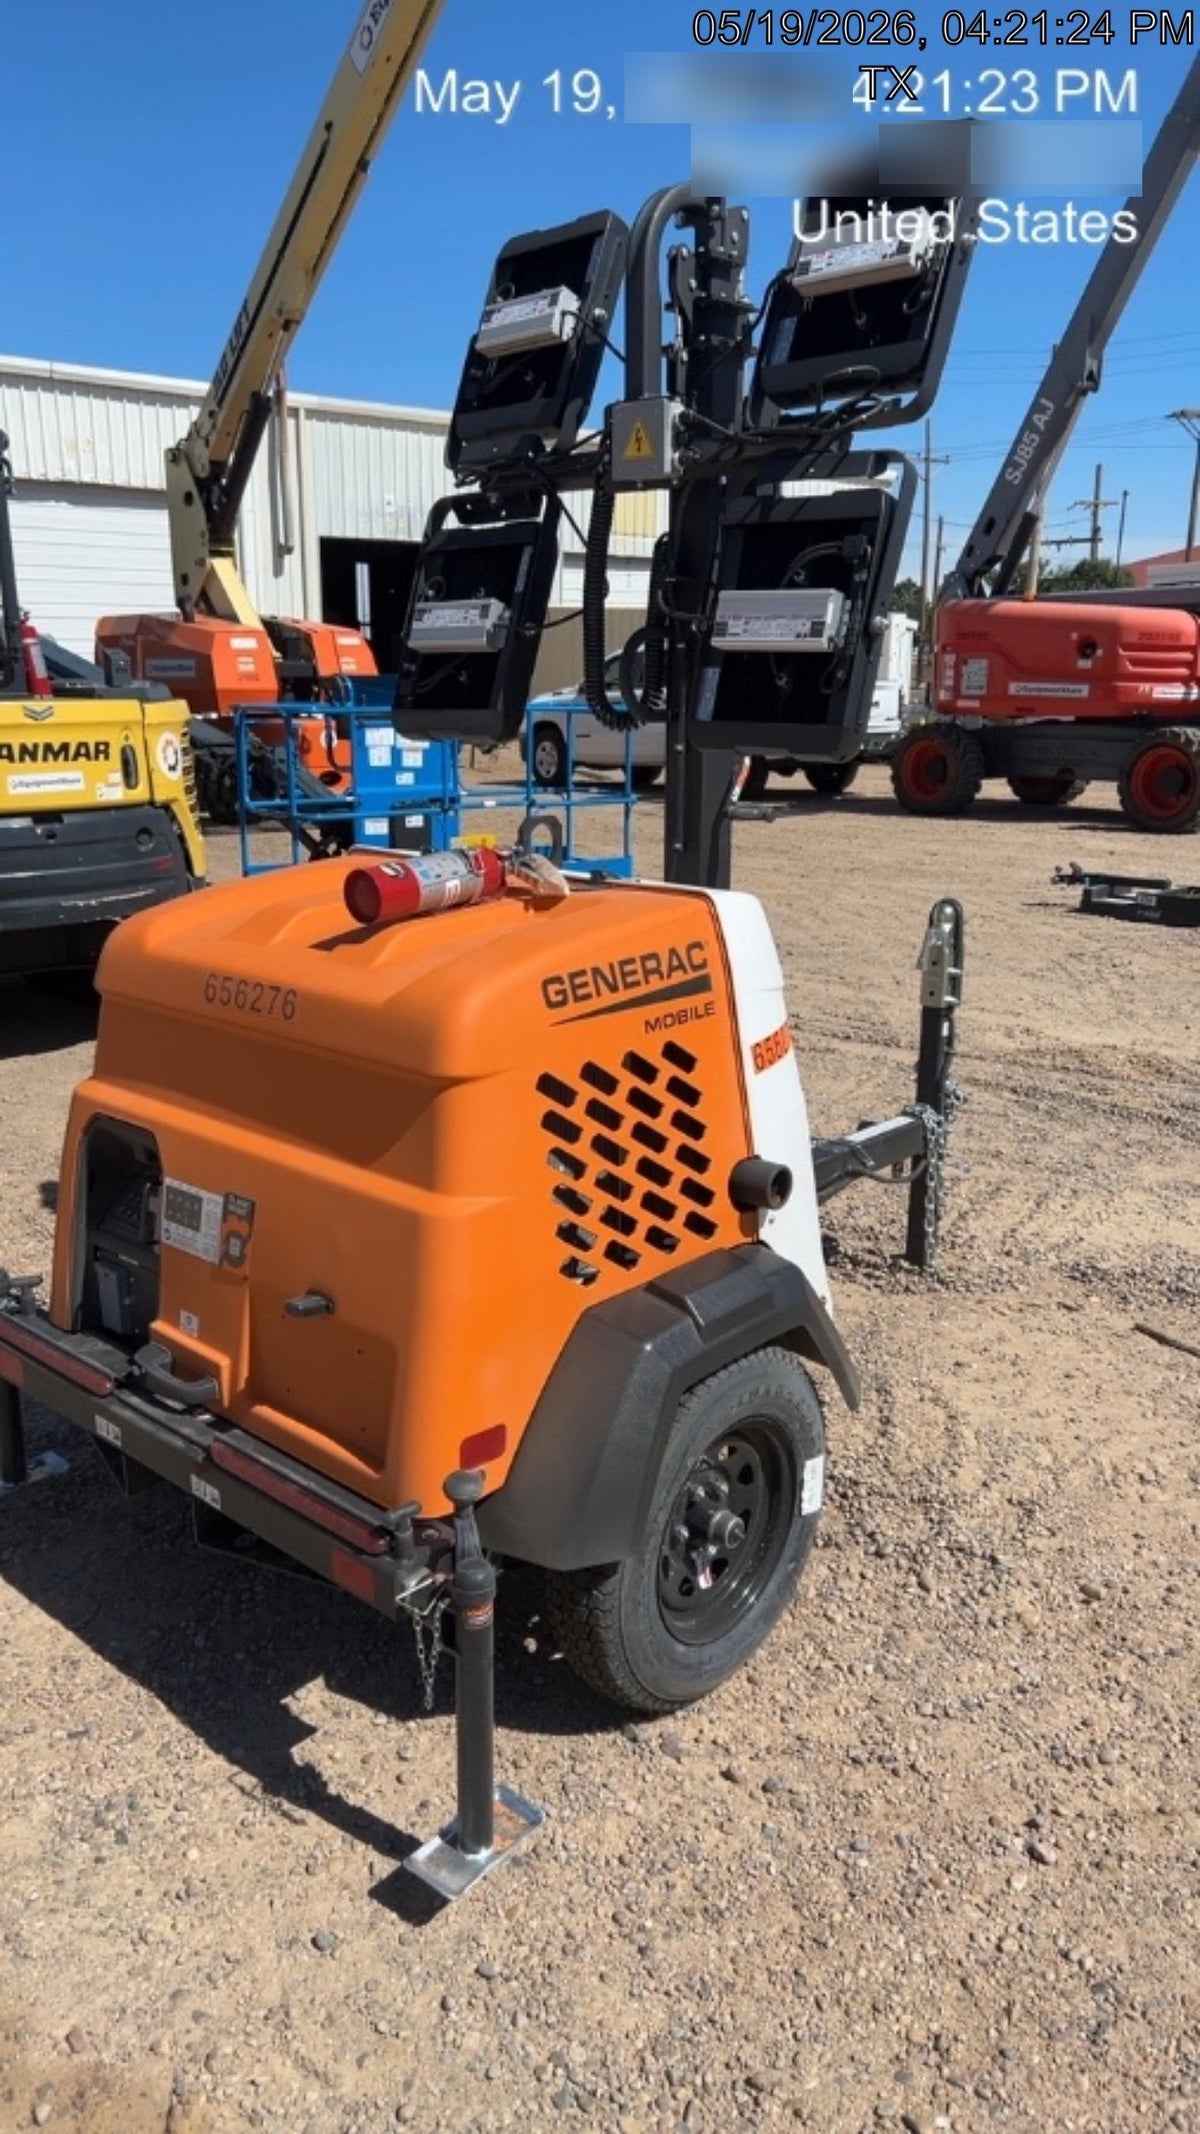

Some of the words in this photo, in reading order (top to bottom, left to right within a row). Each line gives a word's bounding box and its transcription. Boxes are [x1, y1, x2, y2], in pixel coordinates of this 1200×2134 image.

[1032, 397, 1055, 431] AJ
[204, 972, 297, 1021] 656276
[541, 940, 709, 1011] GENERAC
[644, 1000, 716, 1035] MOBILE
